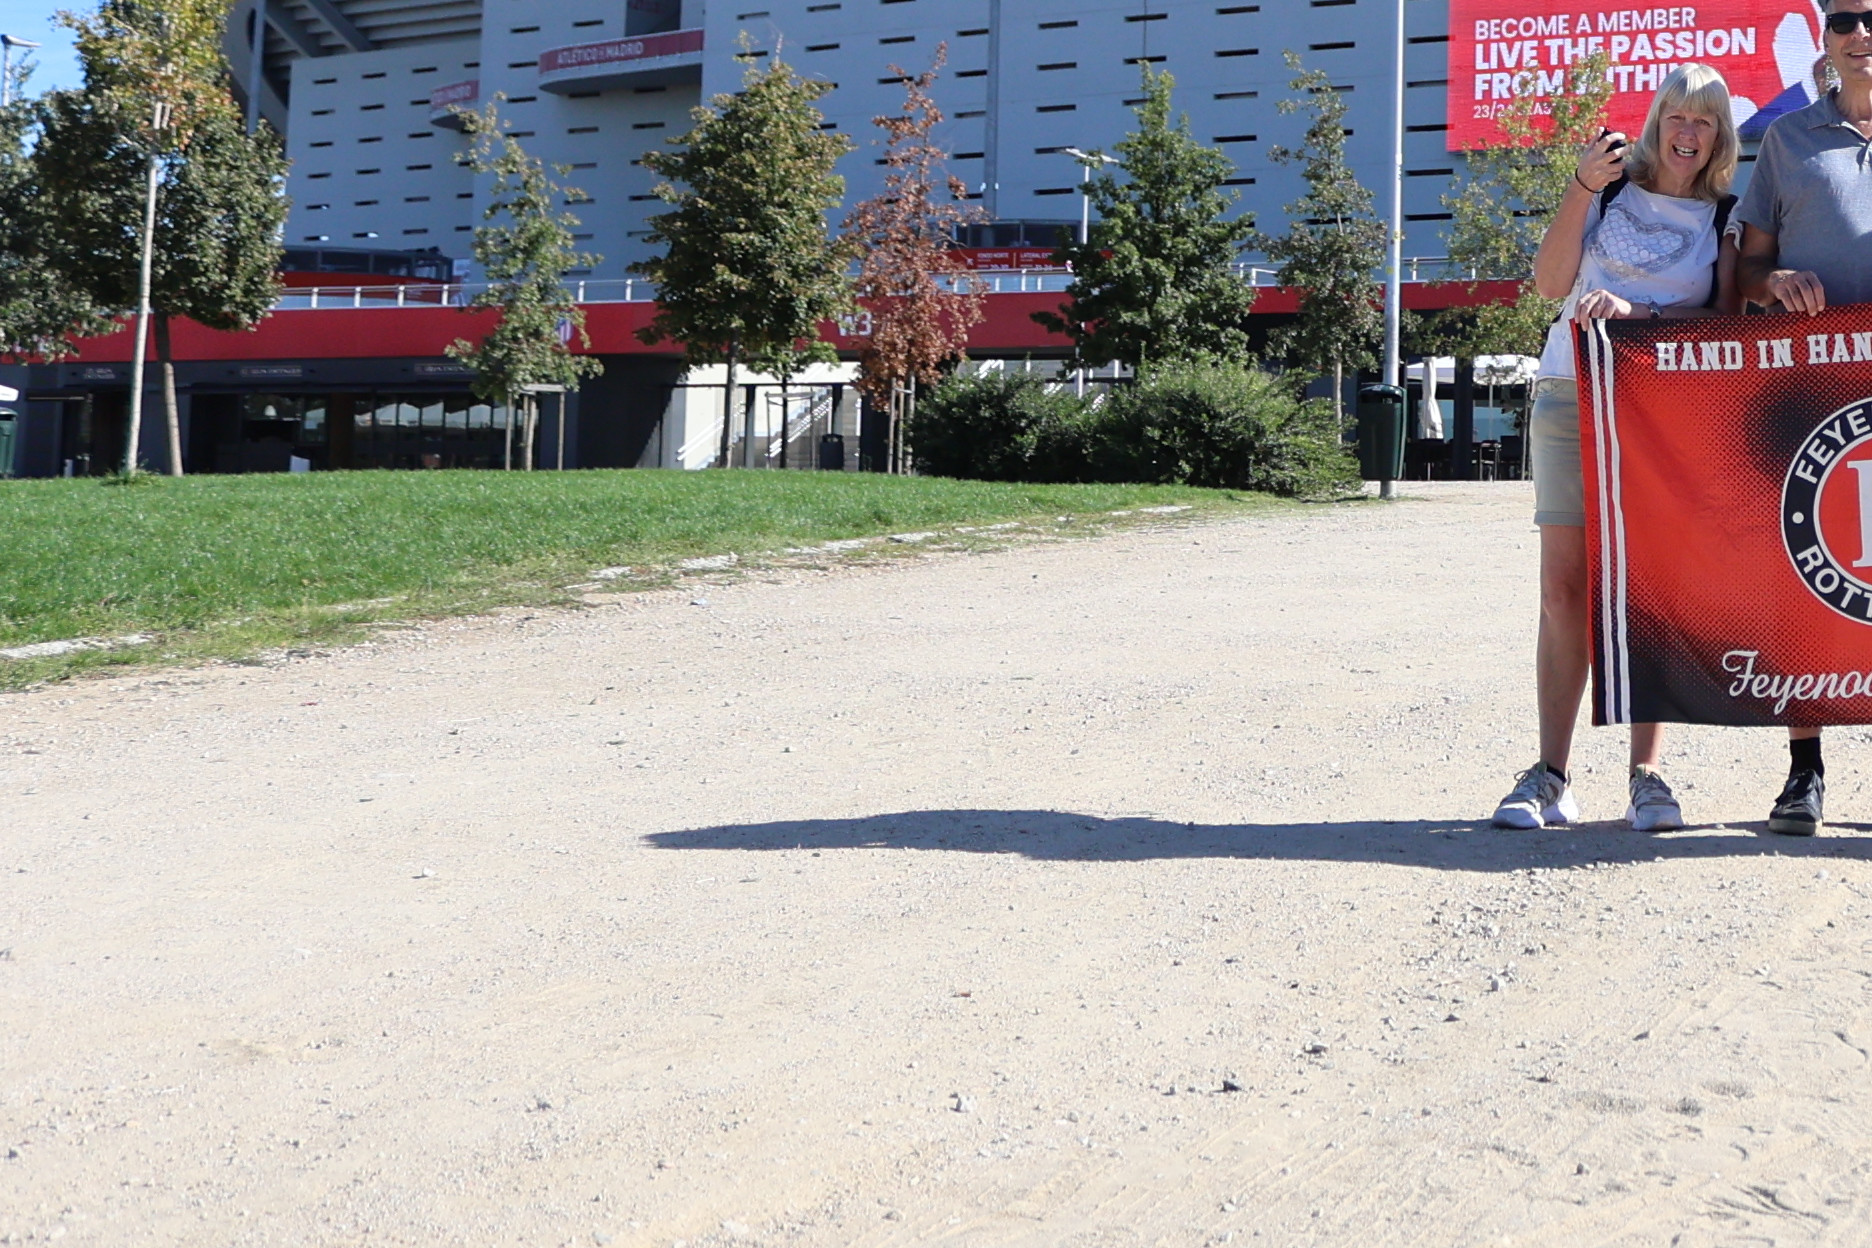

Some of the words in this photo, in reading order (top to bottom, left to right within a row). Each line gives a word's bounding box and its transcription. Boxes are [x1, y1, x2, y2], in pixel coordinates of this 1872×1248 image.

[1474, 14, 1570, 40] BECOME
[1576, 13, 1592, 34] A
[1597, 7, 1696, 33] MEMBER
[1474, 40, 1539, 70] LIVE
[1544, 36, 1604, 67] THE
[1611, 26, 1756, 62] PASSION
[1474, 69, 1565, 101] FROM
[1655, 341, 1745, 371] HAND
[1757, 338, 1795, 369] IN
